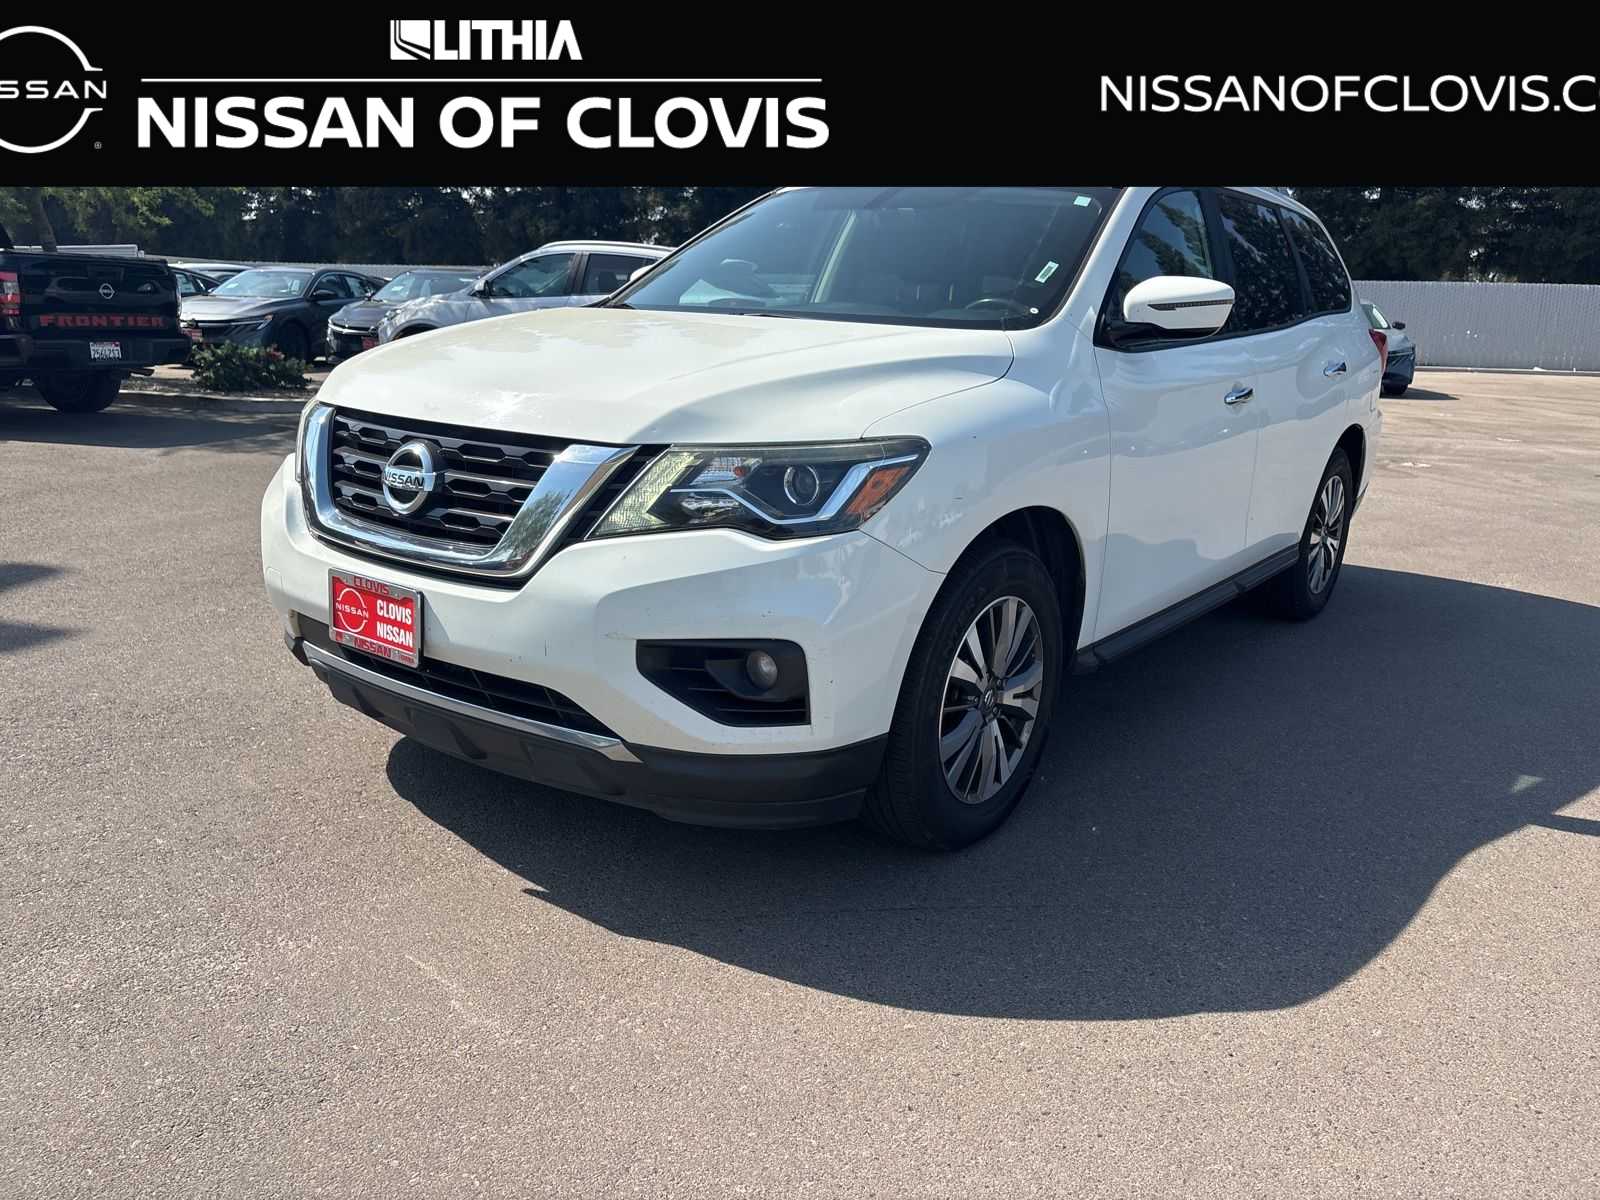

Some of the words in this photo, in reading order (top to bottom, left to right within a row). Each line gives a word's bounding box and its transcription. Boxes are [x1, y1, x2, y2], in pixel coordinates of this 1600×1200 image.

[39, 315, 166, 327] FRONTIER
[384, 470, 425, 487] NISSAN
[353, 576, 390, 595] CLOVIS
[335, 602, 369, 619] NISSAN
[376, 599, 412, 625] CLOVIS
[376, 621, 413, 648] NISSAN
[353, 638, 392, 658] NISSAN
